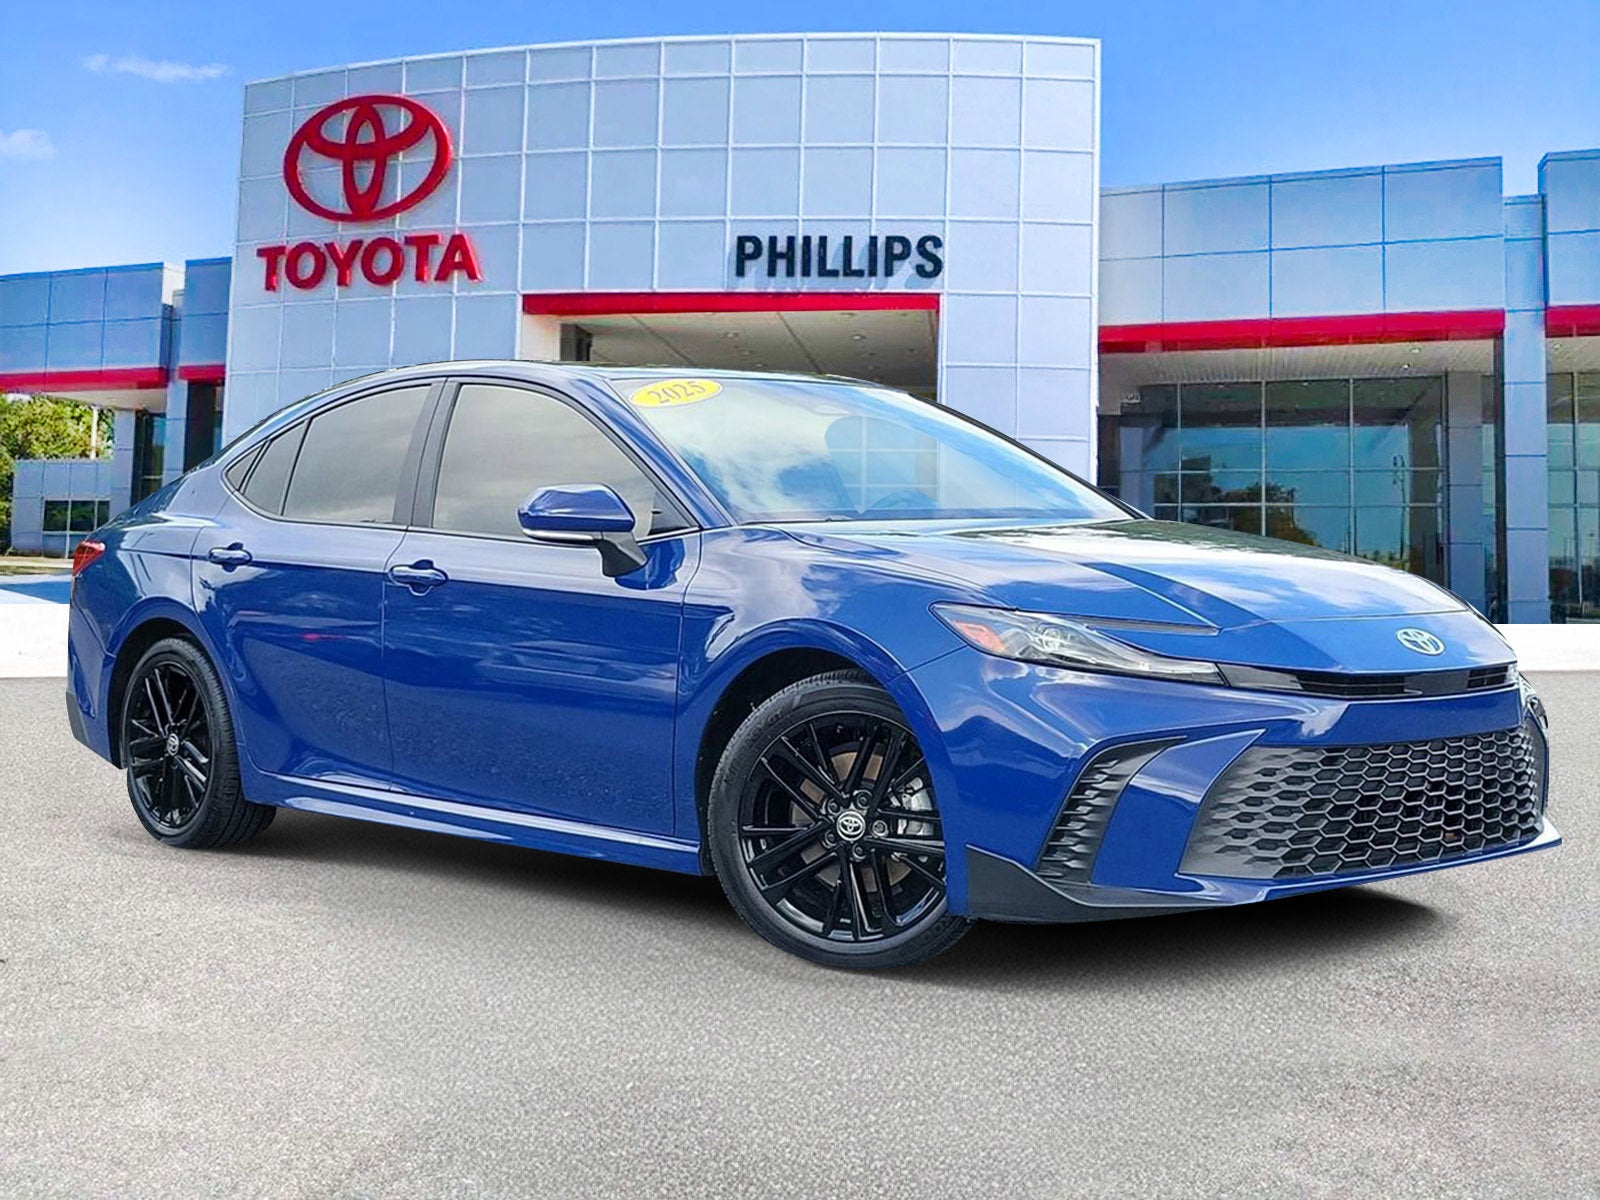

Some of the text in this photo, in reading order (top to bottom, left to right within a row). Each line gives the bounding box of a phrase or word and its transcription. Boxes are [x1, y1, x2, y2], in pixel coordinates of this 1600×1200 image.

[256, 234, 482, 291] TOYOTA
[736, 235, 943, 278] PHILLIPS
[647, 381, 706, 404] 2025
